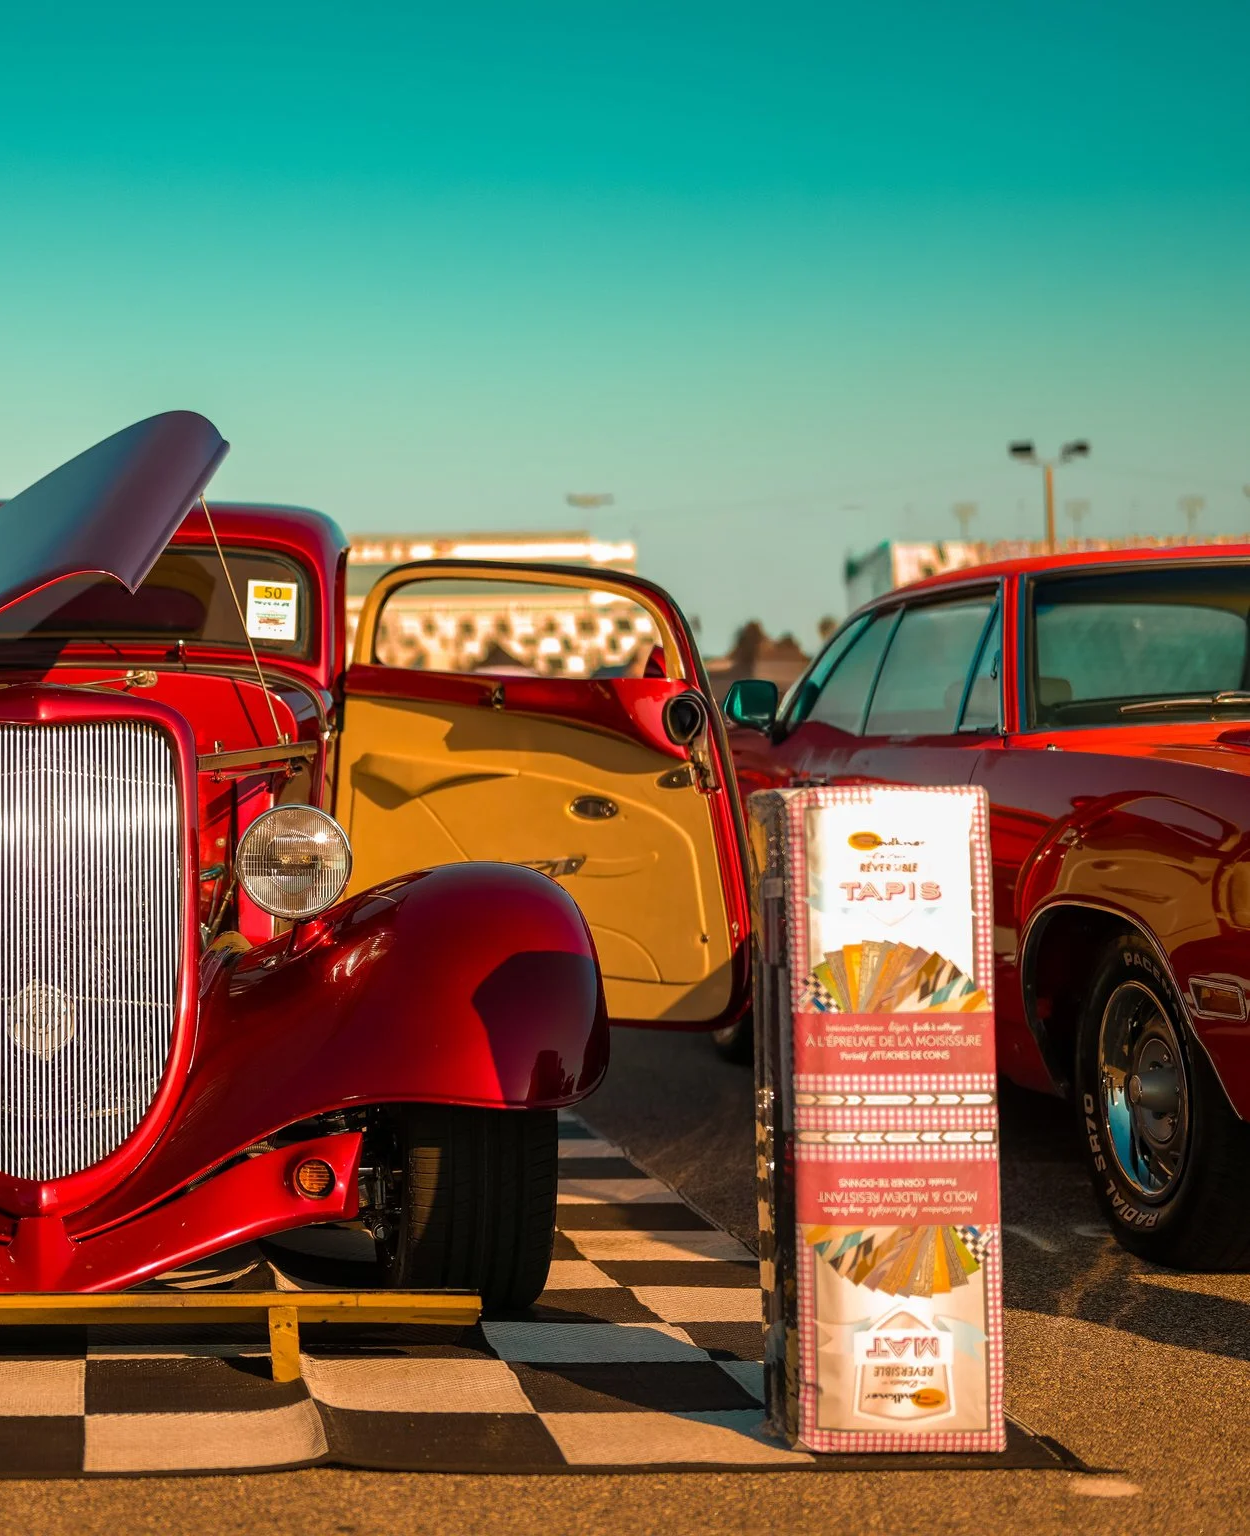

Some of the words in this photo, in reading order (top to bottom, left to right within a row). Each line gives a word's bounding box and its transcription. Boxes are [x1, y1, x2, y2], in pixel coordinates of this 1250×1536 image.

[264, 586, 282, 599] 50
[839, 881, 942, 901] TAPIS
[817, 1033, 877, 1048] L'ÉPREUVE
[879, 1034, 895, 1047] DE
[897, 1034, 912, 1047] LA
[915, 1034, 982, 1047] MOISISSURE
[911, 1050, 923, 1060] DE
[923, 1049, 950, 1060] COINS
[1083, 1092, 1108, 1173] SR70
[838, 1178, 890, 1189] TIE-DOWNS
[891, 1178, 926, 1188] CORNER
[817, 1191, 880, 1204] RESISTANT
[881, 1191, 929, 1203] MILDEW
[932, 1191, 940, 1203] &
[943, 1190, 978, 1203] MOLD
[1105, 1178, 1160, 1228] RADIAL
[866, 1337, 940, 1359] MAT
[873, 1366, 934, 1377] REVERSIBLE
